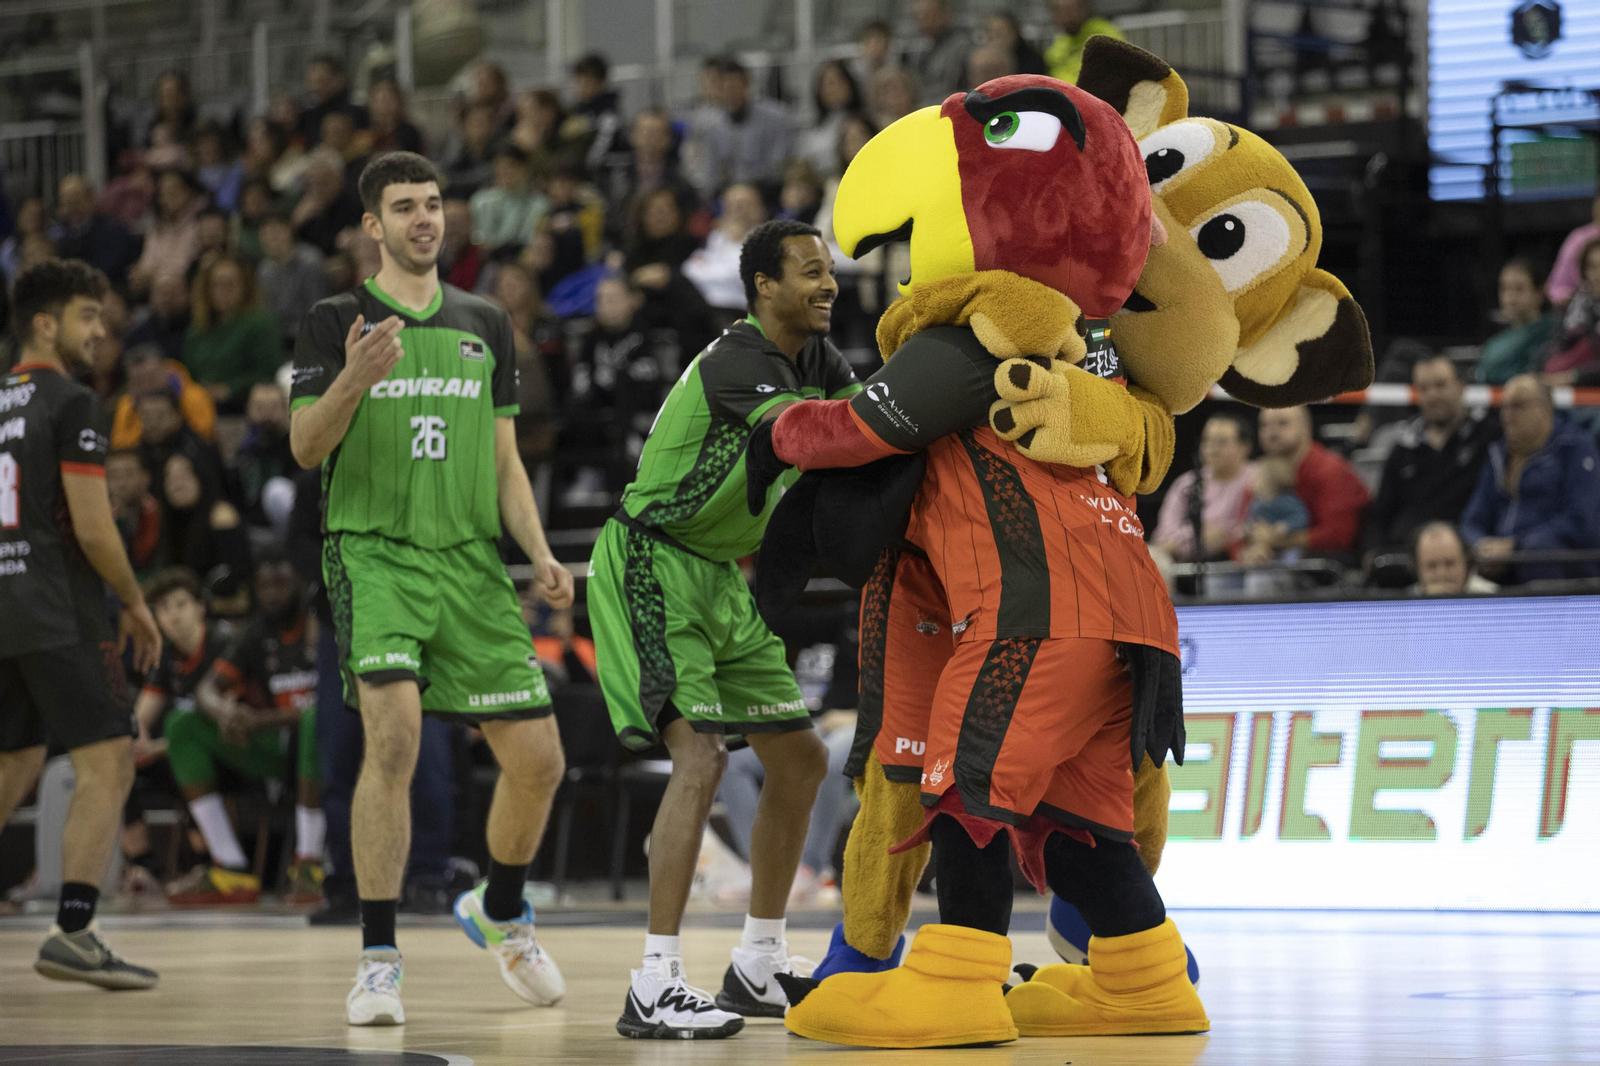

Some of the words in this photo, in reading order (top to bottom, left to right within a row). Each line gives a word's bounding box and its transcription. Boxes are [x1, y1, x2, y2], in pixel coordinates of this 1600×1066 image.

[370, 375, 482, 400] COVIRAN
[410, 414, 447, 460] 26
[481, 689, 531, 707] BERNER
